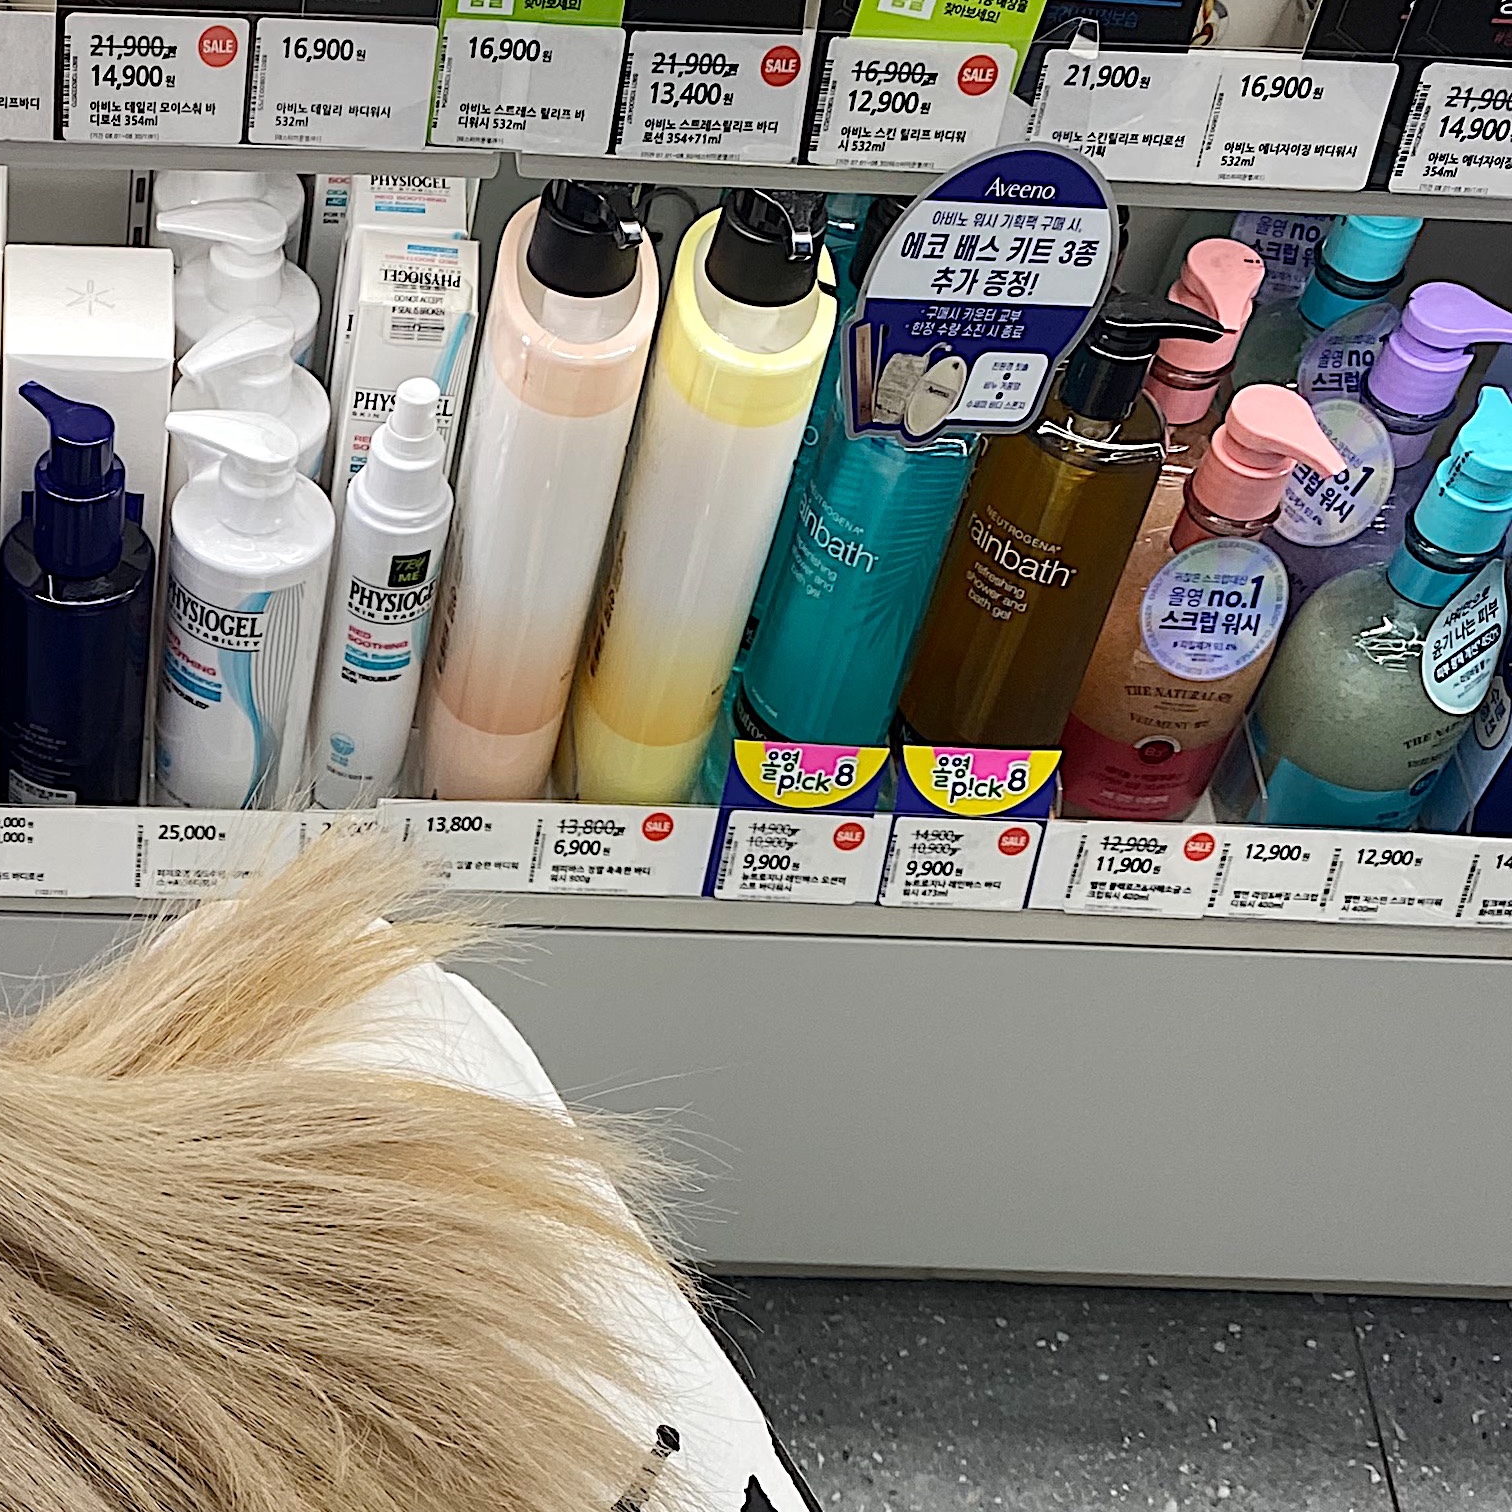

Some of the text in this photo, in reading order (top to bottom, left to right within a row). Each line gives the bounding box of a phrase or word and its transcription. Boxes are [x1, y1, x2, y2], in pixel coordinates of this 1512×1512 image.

[202, 39, 234, 55] SALE
[282, 35, 367, 63] 16,900원
[467, 35, 554, 63] 16,900원
[764, 57, 798, 73] SALE
[90, 64, 176, 91] 14,900원
[961, 67, 995, 83] SALE
[1063, 64, 1151, 91] 21,900원
[649, 81, 735, 108] 13,400원
[1240, 74, 1325, 102] 16,900원
[89, 100, 157, 114] 아비노 데일리
[275, 102, 392, 119] 아비노 데일리 바디워시
[458, 102, 572, 120] 아비노 스트레스 릴리프
[847, 89, 932, 116] 12,900원
[89, 114, 159, 127] 디로션 354ml
[274, 115, 309, 128] 532ml
[457, 115, 527, 131] 디워시 532ml
[643, 118, 780, 134] 아비노 바디
[641, 132, 722, 145] 로션 354+71ml
[840, 125, 967, 143] 아비노 스킨 릴리프 바디워
[1051, 130, 1084, 144] 아비노
[1141, 133, 1186, 149] 바디로션
[851, 140, 886, 153] 532ml
[1223, 140, 1255, 154] 아비노
[1313, 144, 1359, 158] 바디워시
[1220, 155, 1256, 168] 532ml
[1427, 151, 1459, 165] 아비노
[1421, 165, 1458, 178] 354ml
[370, 174, 451, 191] PHYSIOGEL
[983, 176, 1057, 201] Aveeno
[931, 210, 969, 228] 아비노
[972, 212, 998, 229] 워시
[999, 213, 1039, 231] 기획팩
[1040, 215, 1067, 232] 구매
[900, 231, 1101, 268] 에코 배스 키트 3종
[379, 268, 462, 290] PHYSIOGEL
[930, 266, 1041, 298] 추가 증정!
[961, 307, 1024, 324] 카운터 교부
[910, 322, 1026, 339] 한정 수량 소진 시 종료
[1319, 486, 1356, 524] 워시
[985, 504, 1057, 554] NEUTROGENA
[398, 571, 420, 584] ME
[974, 561, 1026, 600] refreshing
[965, 569, 1028, 613] shower and
[1168, 574, 1265, 610] 올영 no.1
[967, 587, 1012, 622] bath gel
[1158, 610, 1261, 637] 스크럽 워시
[1454, 617, 1477, 642] 나는
[1477, 597, 1500, 624] 피부
[1123, 684, 1217, 703] THE NATURAL
[761, 749, 854, 797] 올영 p!ck 8
[932, 755, 1027, 804] 올영 p!ck 8
[644, 820, 672, 834] SALE
[836, 830, 864, 843] SALE
[999, 835, 1027, 849] SALE
[1186, 841, 1214, 853] SALE
